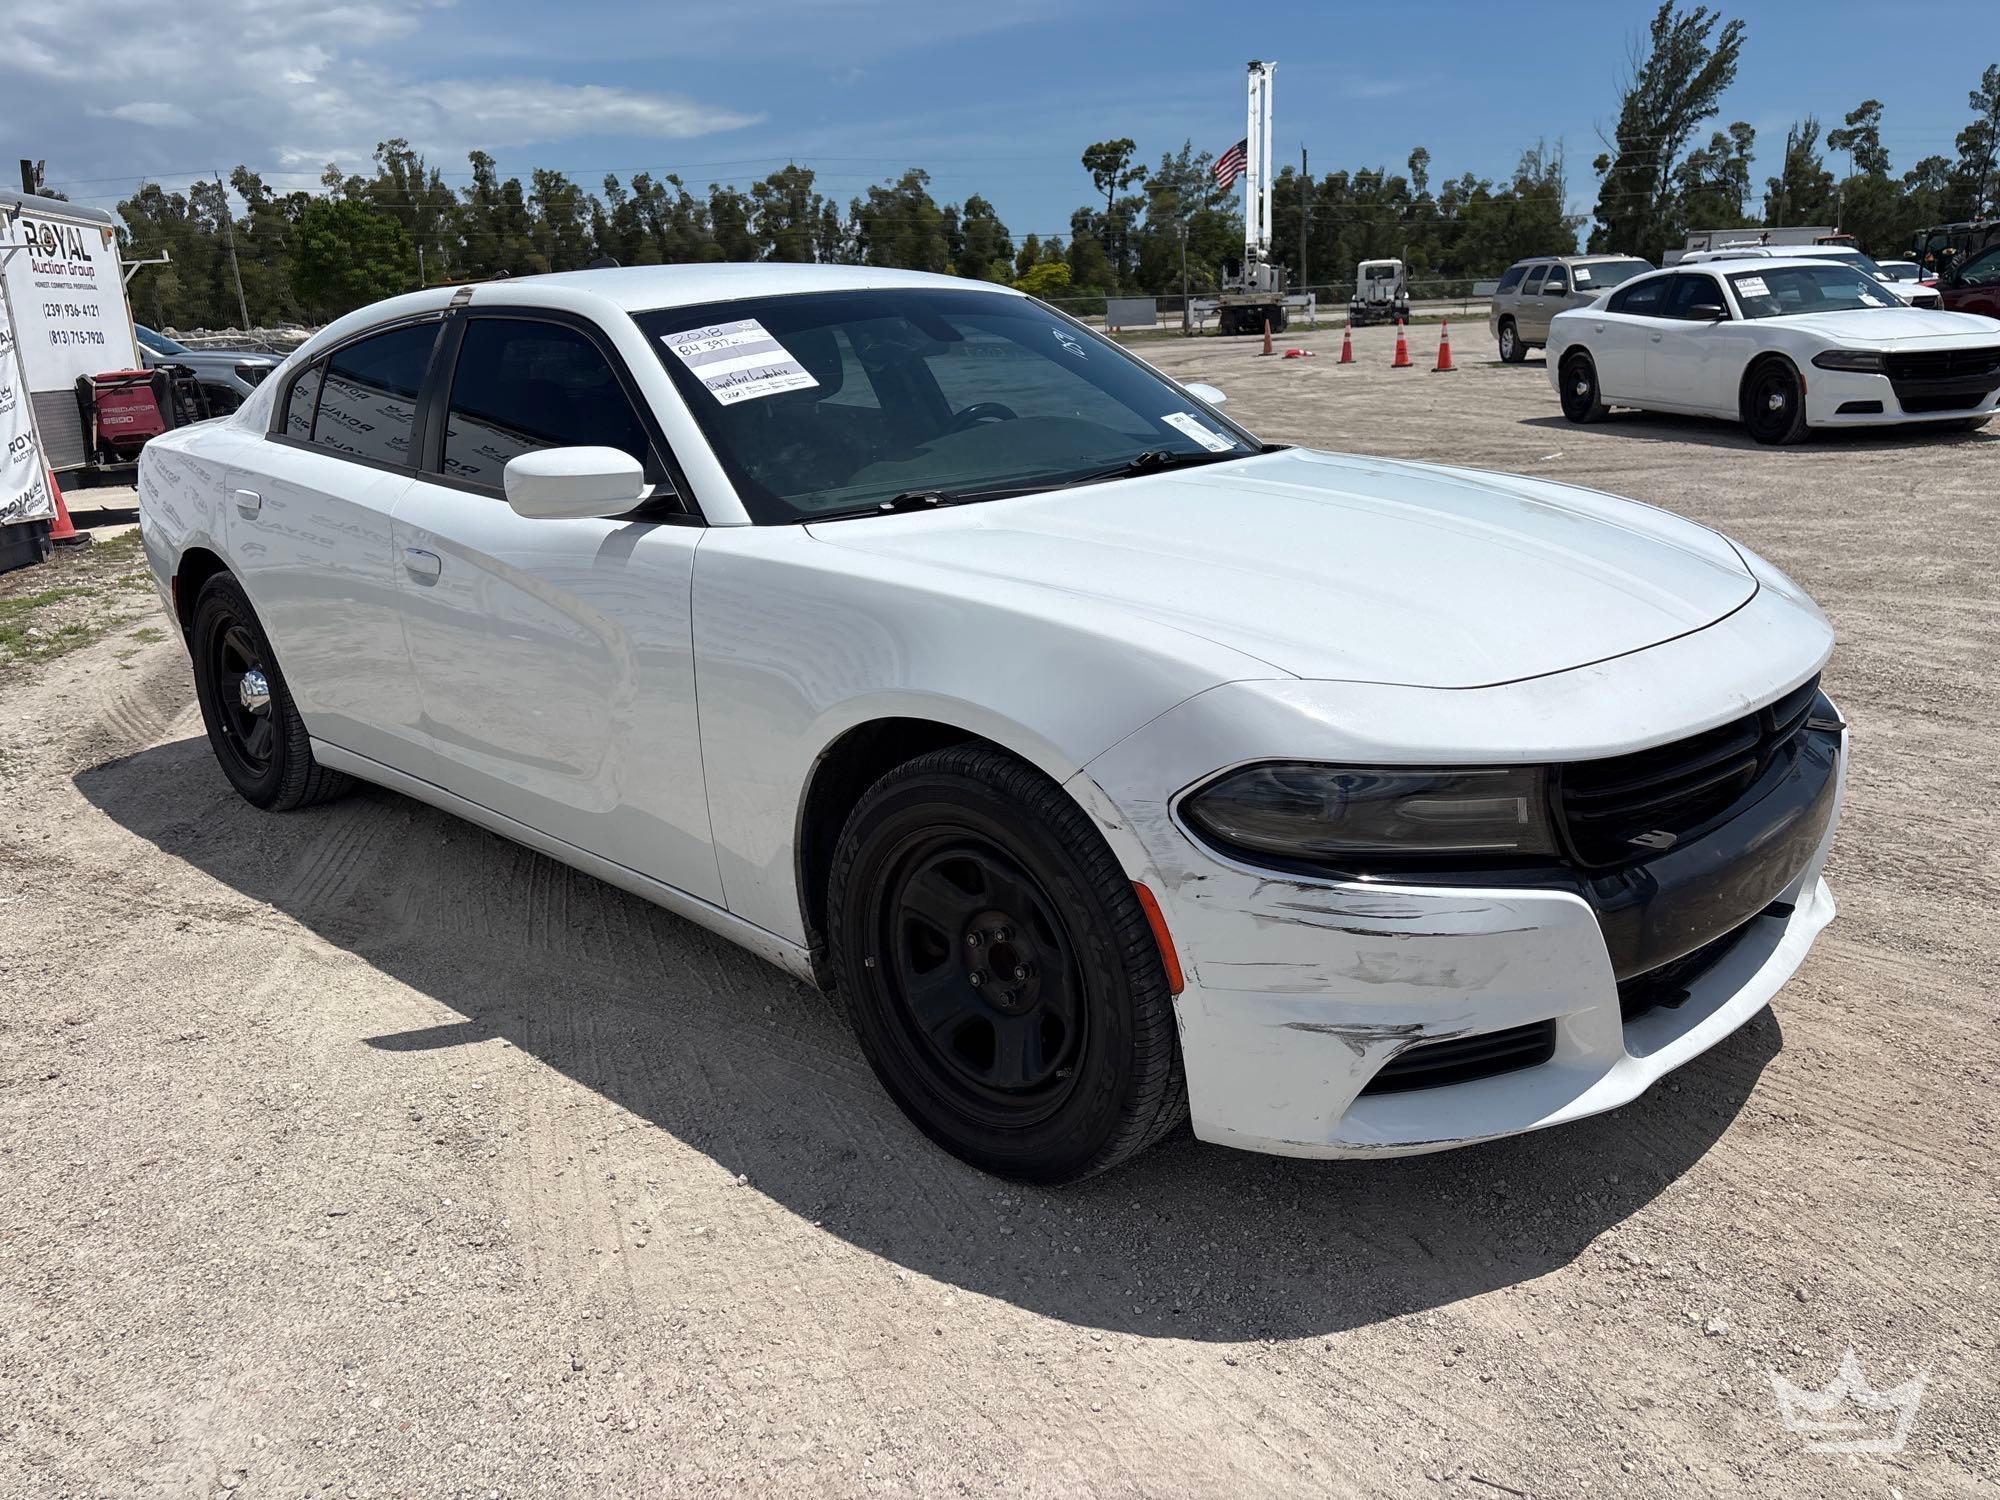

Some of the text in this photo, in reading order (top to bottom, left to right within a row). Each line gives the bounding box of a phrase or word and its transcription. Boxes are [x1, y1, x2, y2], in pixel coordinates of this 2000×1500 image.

[22, 220, 92, 262] ROYAL
[32, 258, 96, 280] Auction Group
[43, 303, 64, 319] (239)
[49, 330, 70, 346] (813)
[671, 327, 723, 344] 2018
[101, 404, 155, 414] PREDATOR
[27, 494, 46, 512] GROUP
